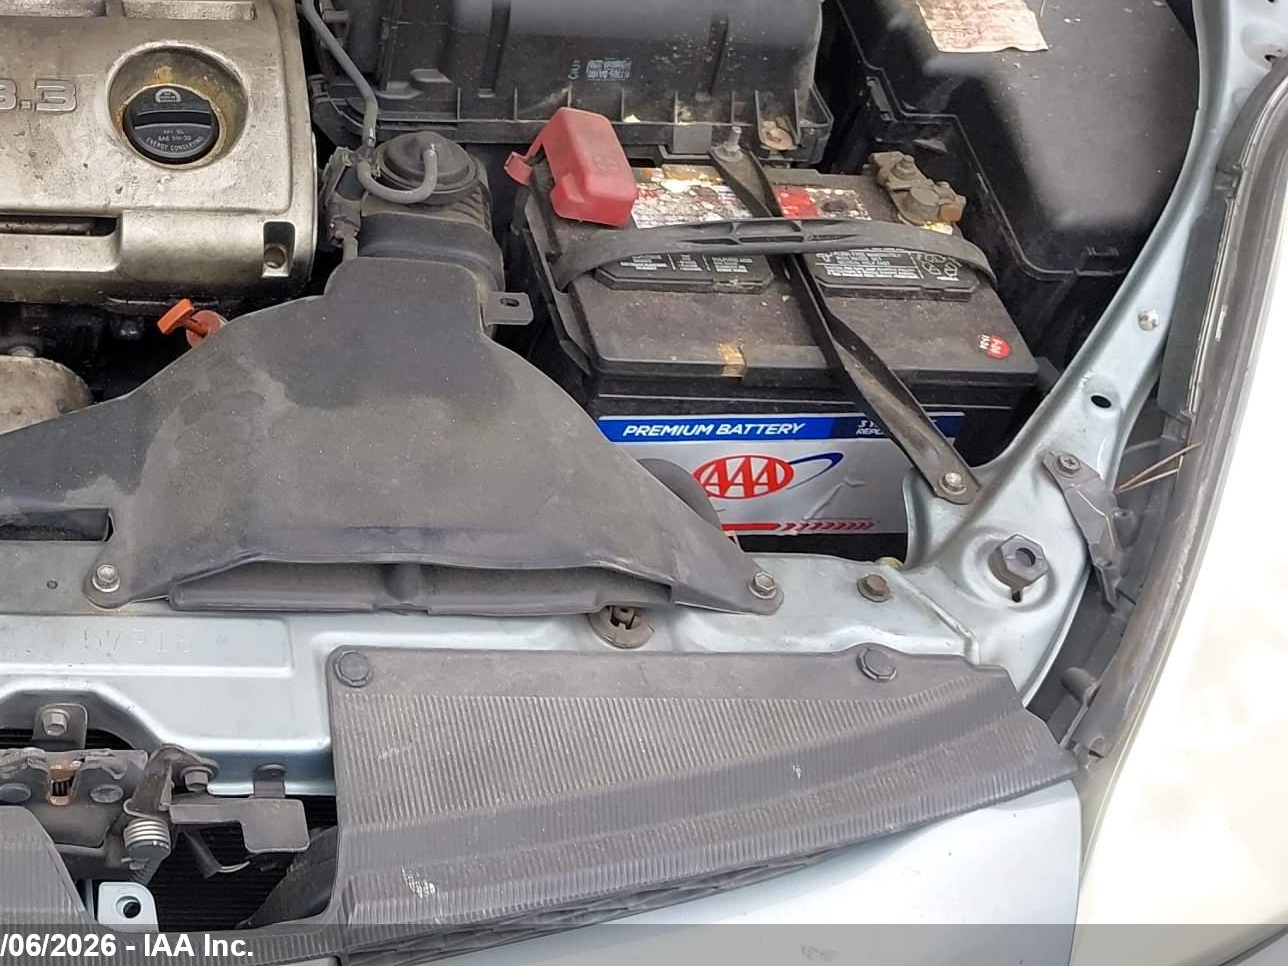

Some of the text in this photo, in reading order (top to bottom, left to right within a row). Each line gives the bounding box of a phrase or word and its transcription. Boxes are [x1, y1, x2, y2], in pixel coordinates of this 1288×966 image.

[622, 422, 807, 437] PREMIUM BATTERY
[702, 455, 782, 499] AAA
